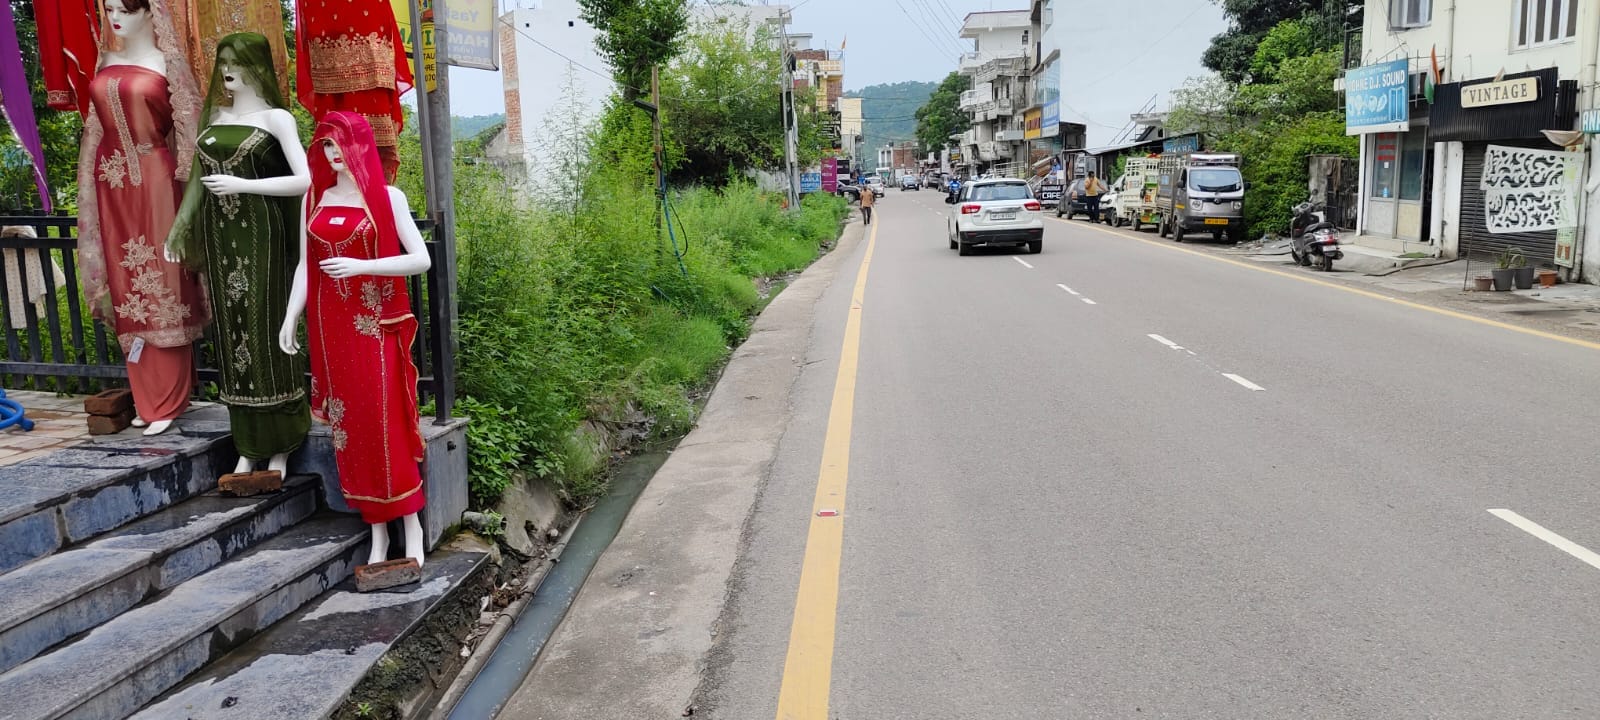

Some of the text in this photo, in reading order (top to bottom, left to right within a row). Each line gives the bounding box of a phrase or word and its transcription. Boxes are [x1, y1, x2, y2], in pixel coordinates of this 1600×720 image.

[1382, 69, 1405, 88] SOUND
[1469, 83, 1528, 103] VINTAGE
[1042, 191, 1061, 199] CAFE
